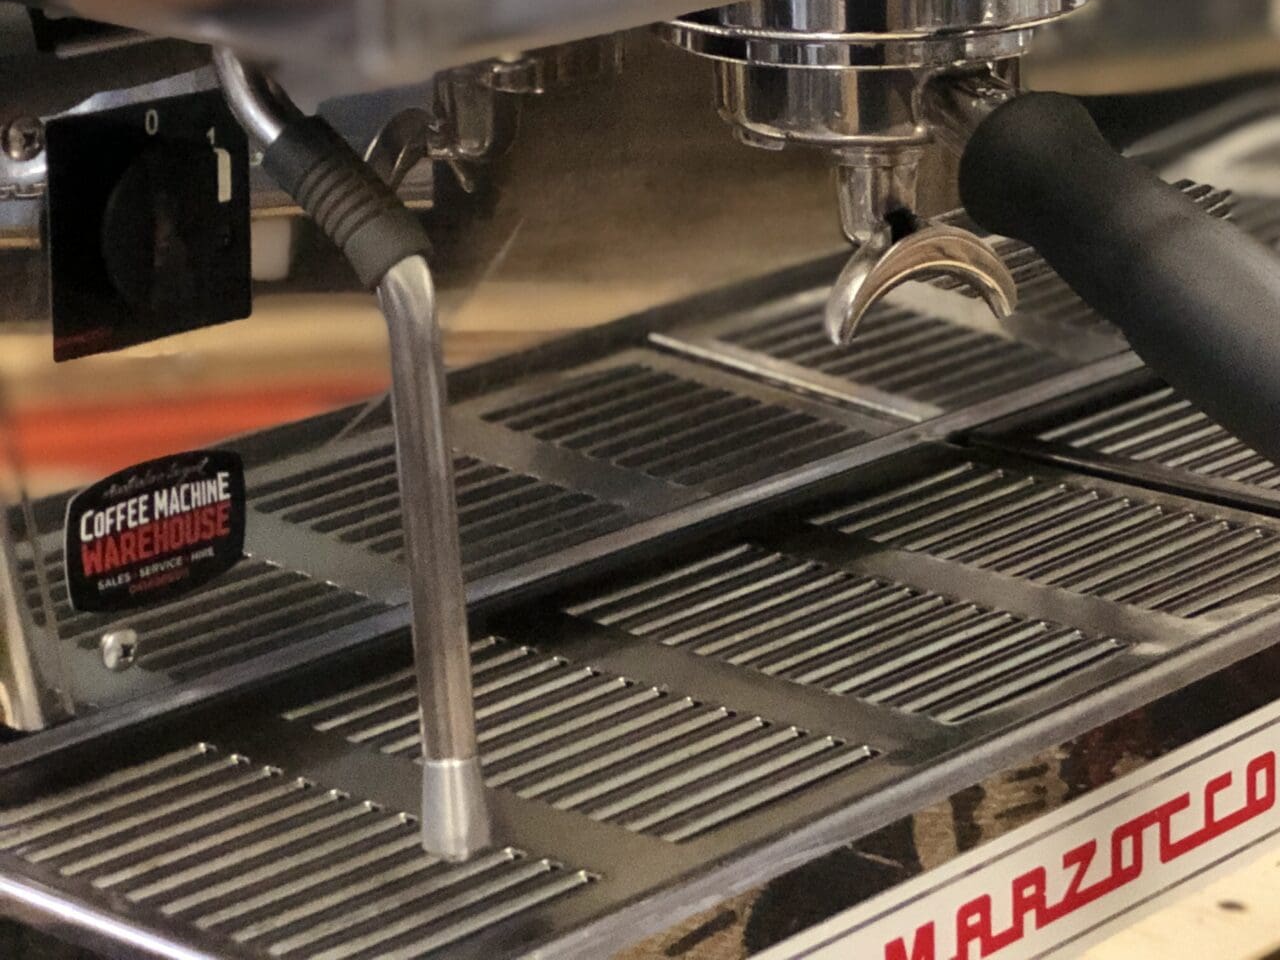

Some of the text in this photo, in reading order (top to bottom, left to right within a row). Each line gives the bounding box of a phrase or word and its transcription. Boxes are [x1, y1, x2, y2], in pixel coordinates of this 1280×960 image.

[80, 495, 149, 541] COFFEE
[154, 472, 231, 521] MACHINE
[80, 501, 231, 576] WAREHOUSE
[97, 572, 131, 591] SALES
[139, 556, 184, 578] SERVICE
